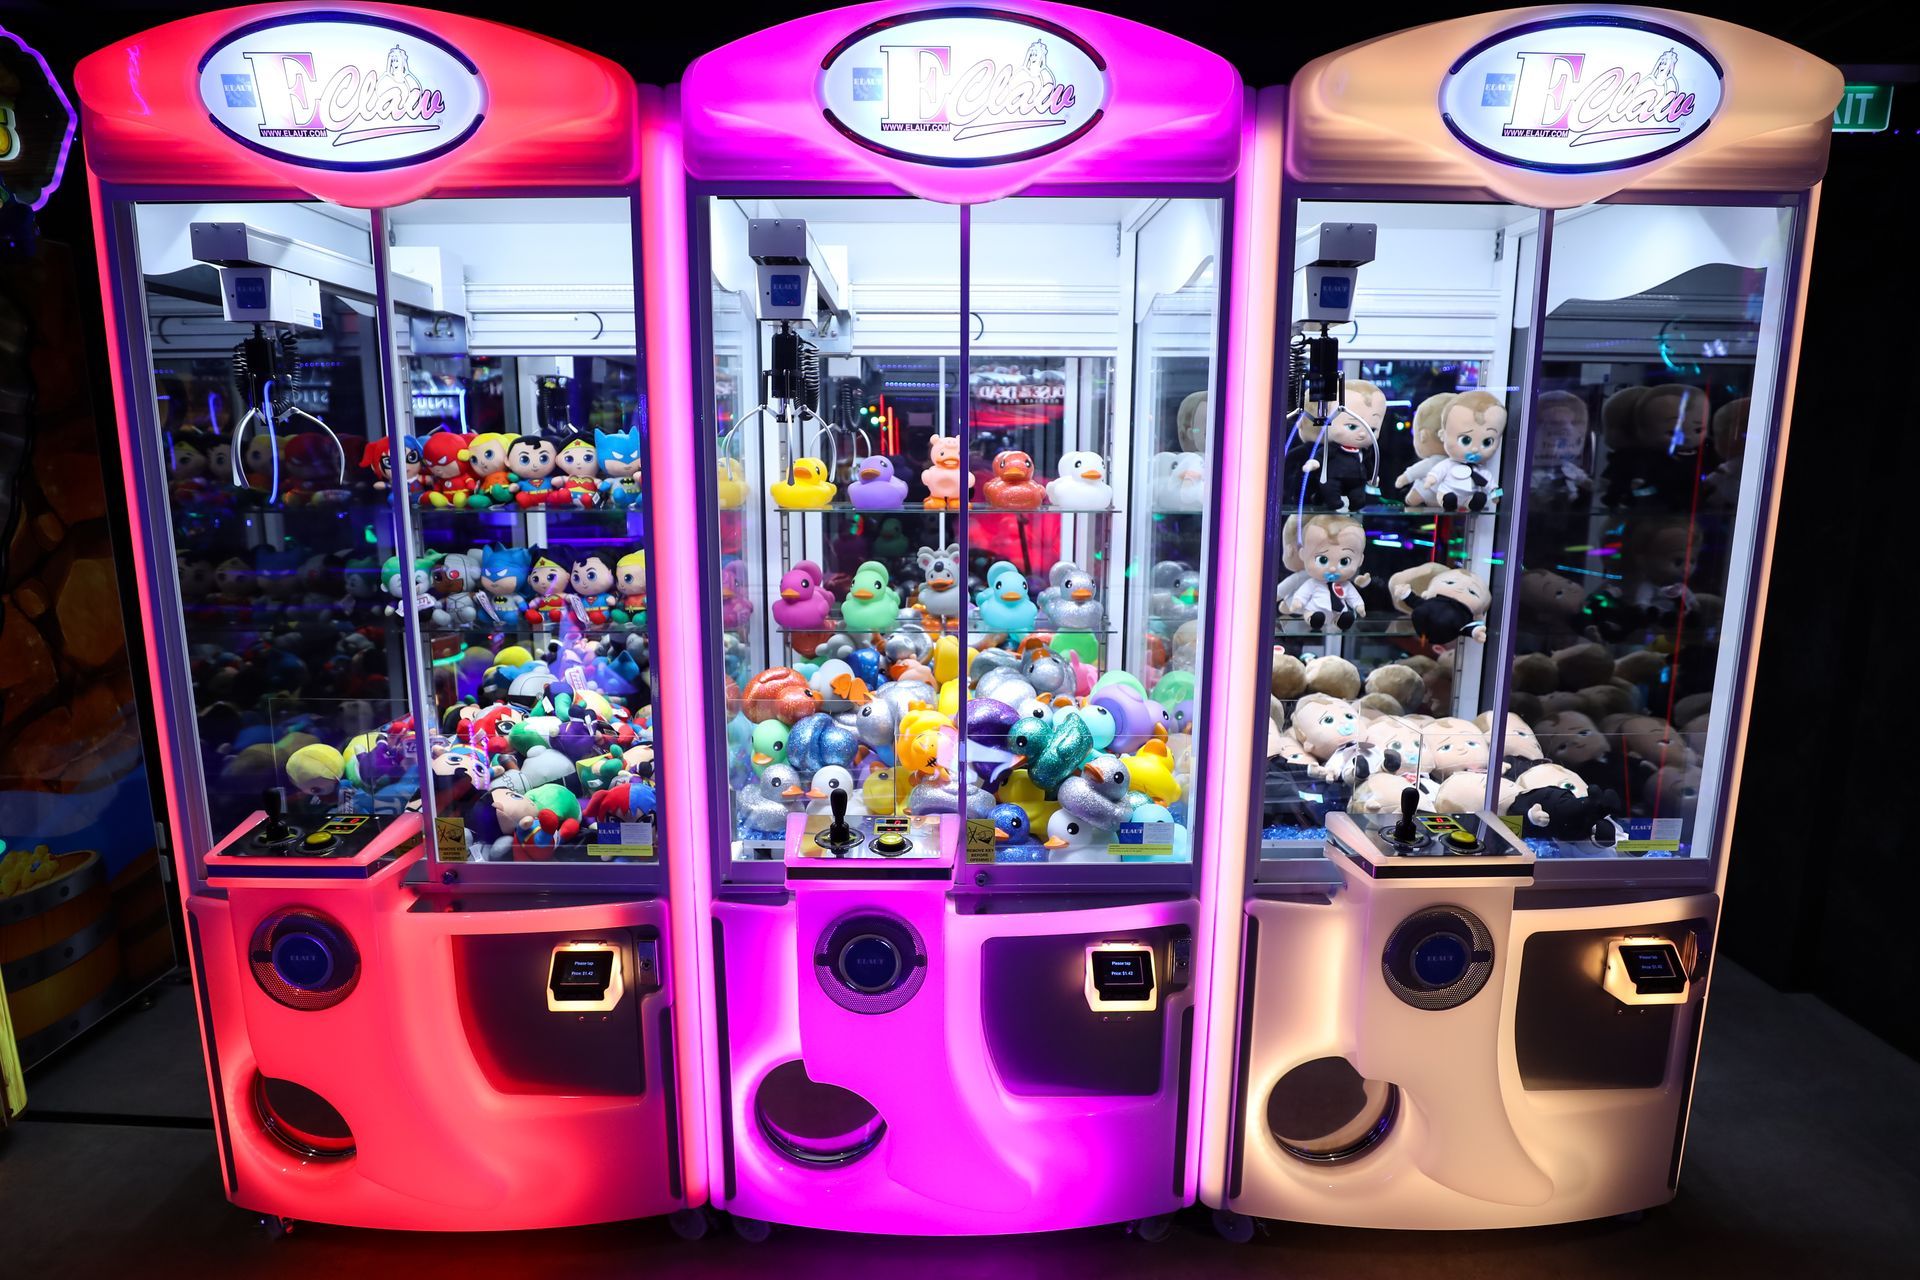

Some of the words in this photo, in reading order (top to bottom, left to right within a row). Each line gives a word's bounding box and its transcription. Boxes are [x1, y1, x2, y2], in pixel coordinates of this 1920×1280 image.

[223, 84, 253, 92] ELAUT
[1484, 83, 1513, 91] ELAUT
[882, 123, 950, 131] WWW.ELAUT.COM
[261, 129, 327, 137] WWW.ELAUT.COM
[1503, 129, 1569, 138] WWW.ELAUT.COM
